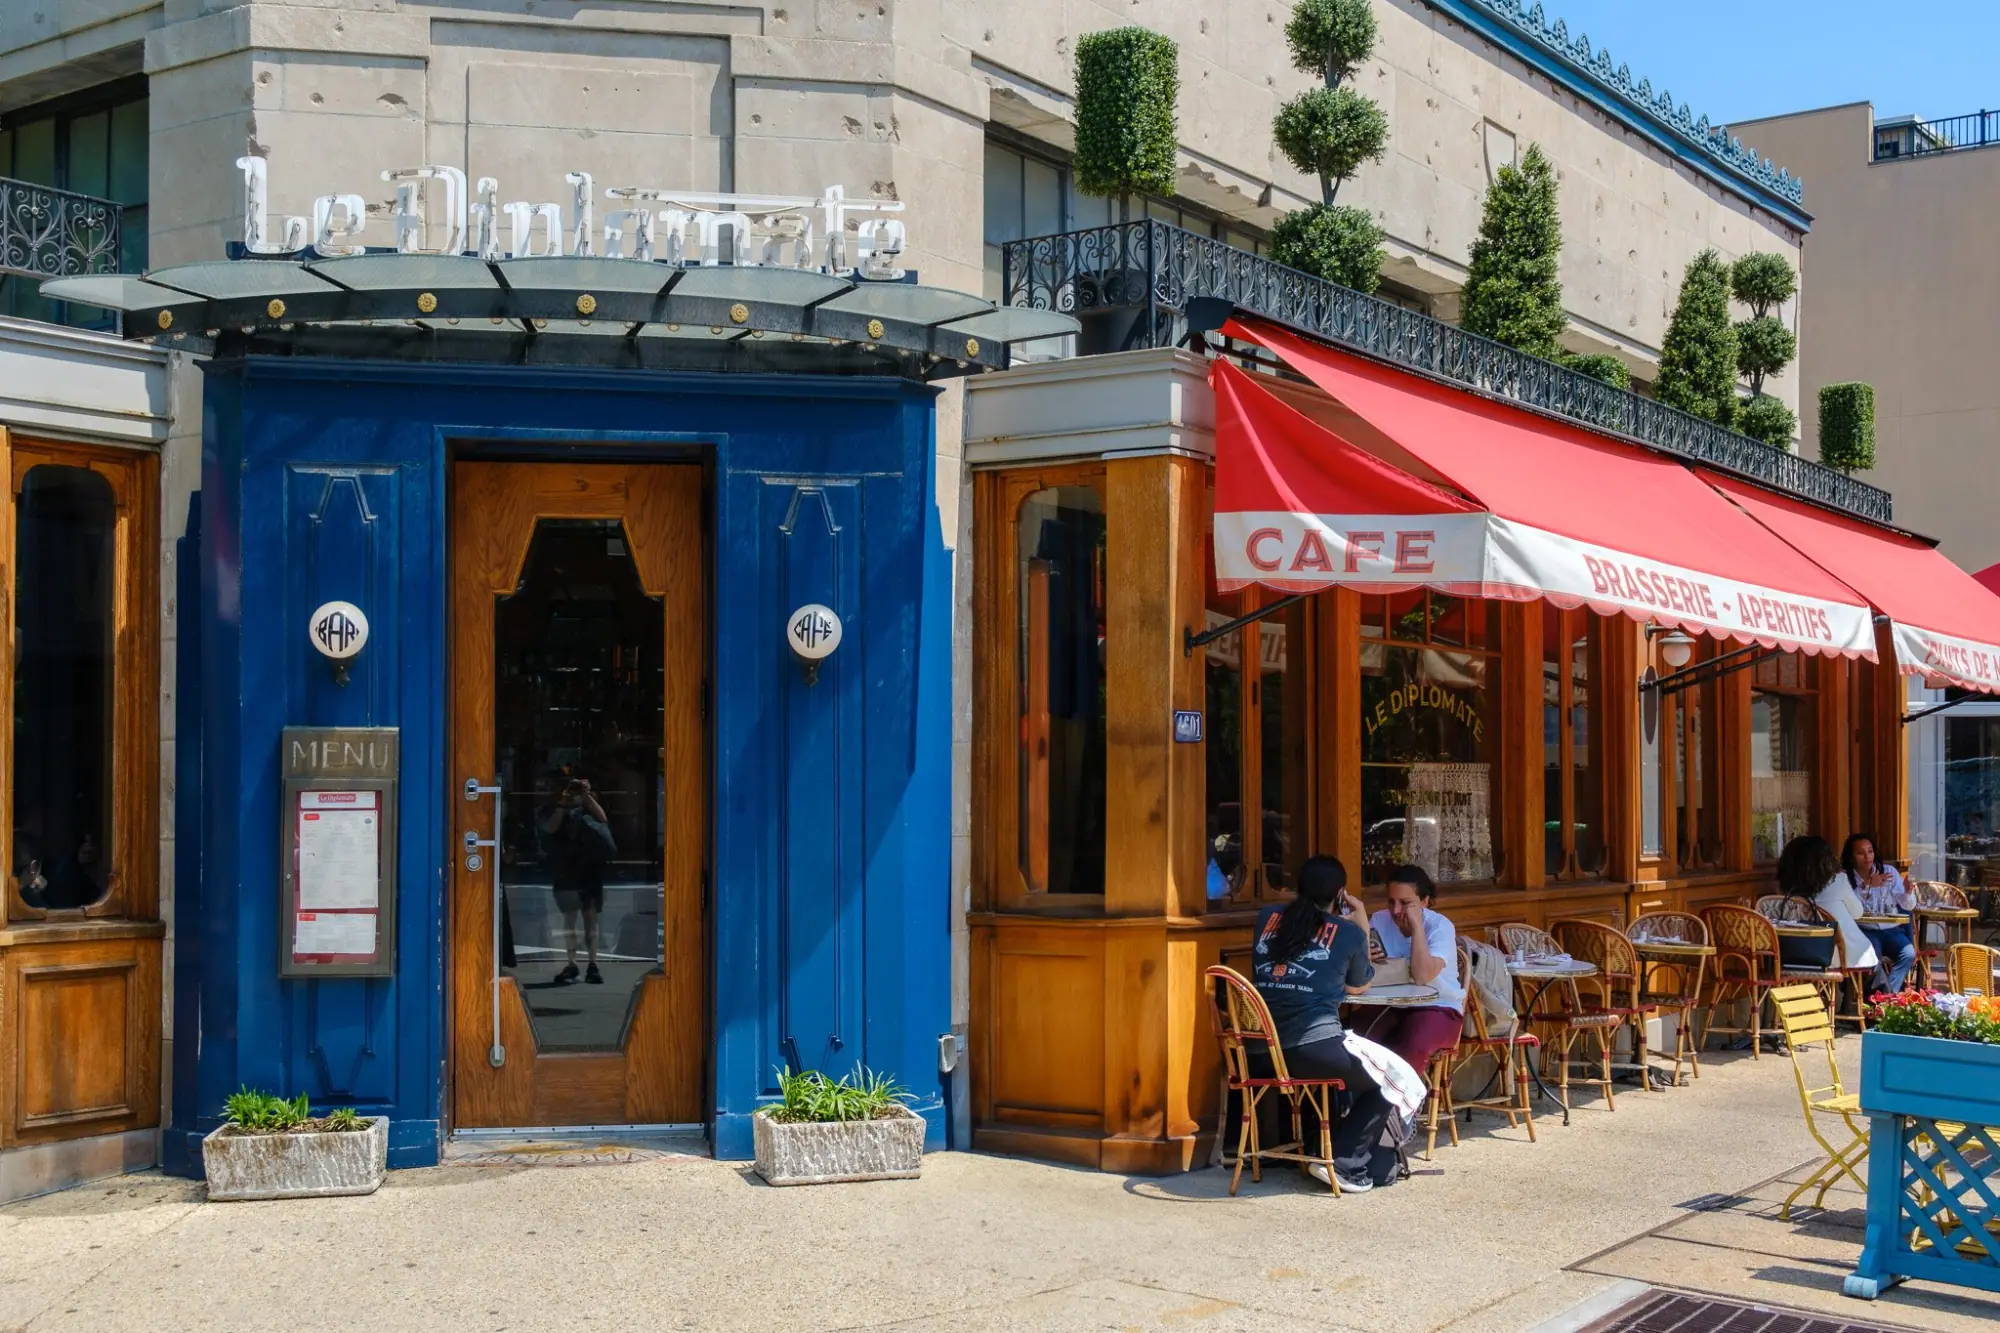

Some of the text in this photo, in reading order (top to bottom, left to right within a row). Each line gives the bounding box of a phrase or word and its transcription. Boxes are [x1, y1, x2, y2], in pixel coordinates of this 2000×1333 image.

[236, 156, 366, 257] Le
[1245, 528, 1436, 574] CAFE
[1582, 553, 1719, 620] BRASSERIE
[318, 611, 356, 653] BAR
[1971, 650, 1991, 679] DE
[1364, 683, 1484, 743] LE DIPLOMATE
[292, 740, 388, 769] MENU
